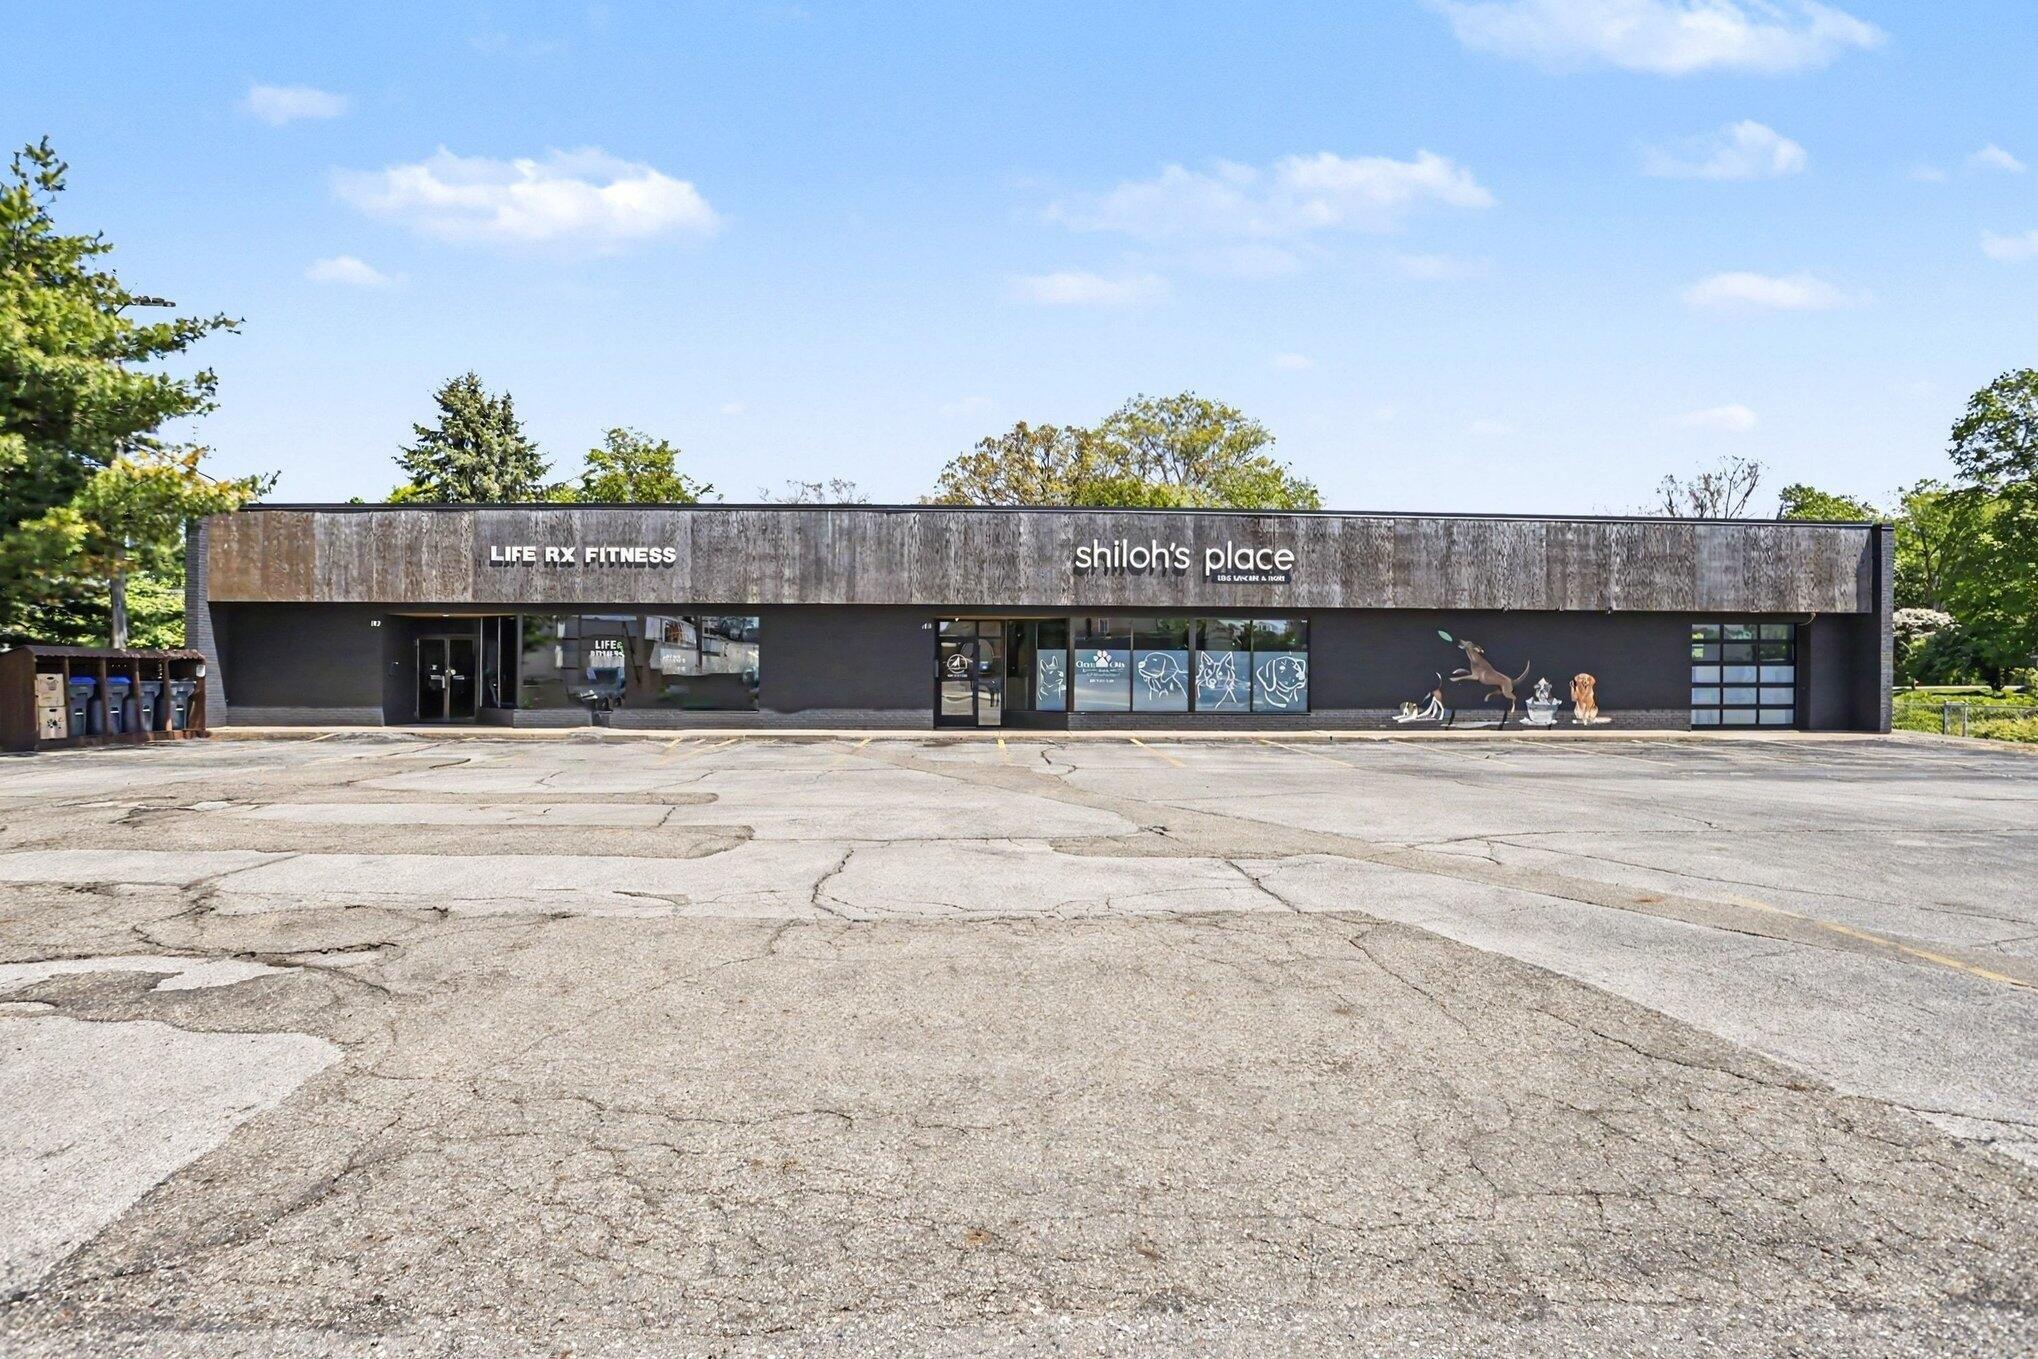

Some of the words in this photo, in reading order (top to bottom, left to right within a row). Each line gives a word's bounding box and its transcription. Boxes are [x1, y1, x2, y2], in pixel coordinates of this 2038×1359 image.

[490, 546, 537, 562] LIFE
[545, 547, 576, 563] RX
[585, 547, 677, 563] FITNESS
[1075, 539, 1190, 569] shiloh's
[1205, 540, 1295, 576] place
[594, 640, 617, 650] LIFE
